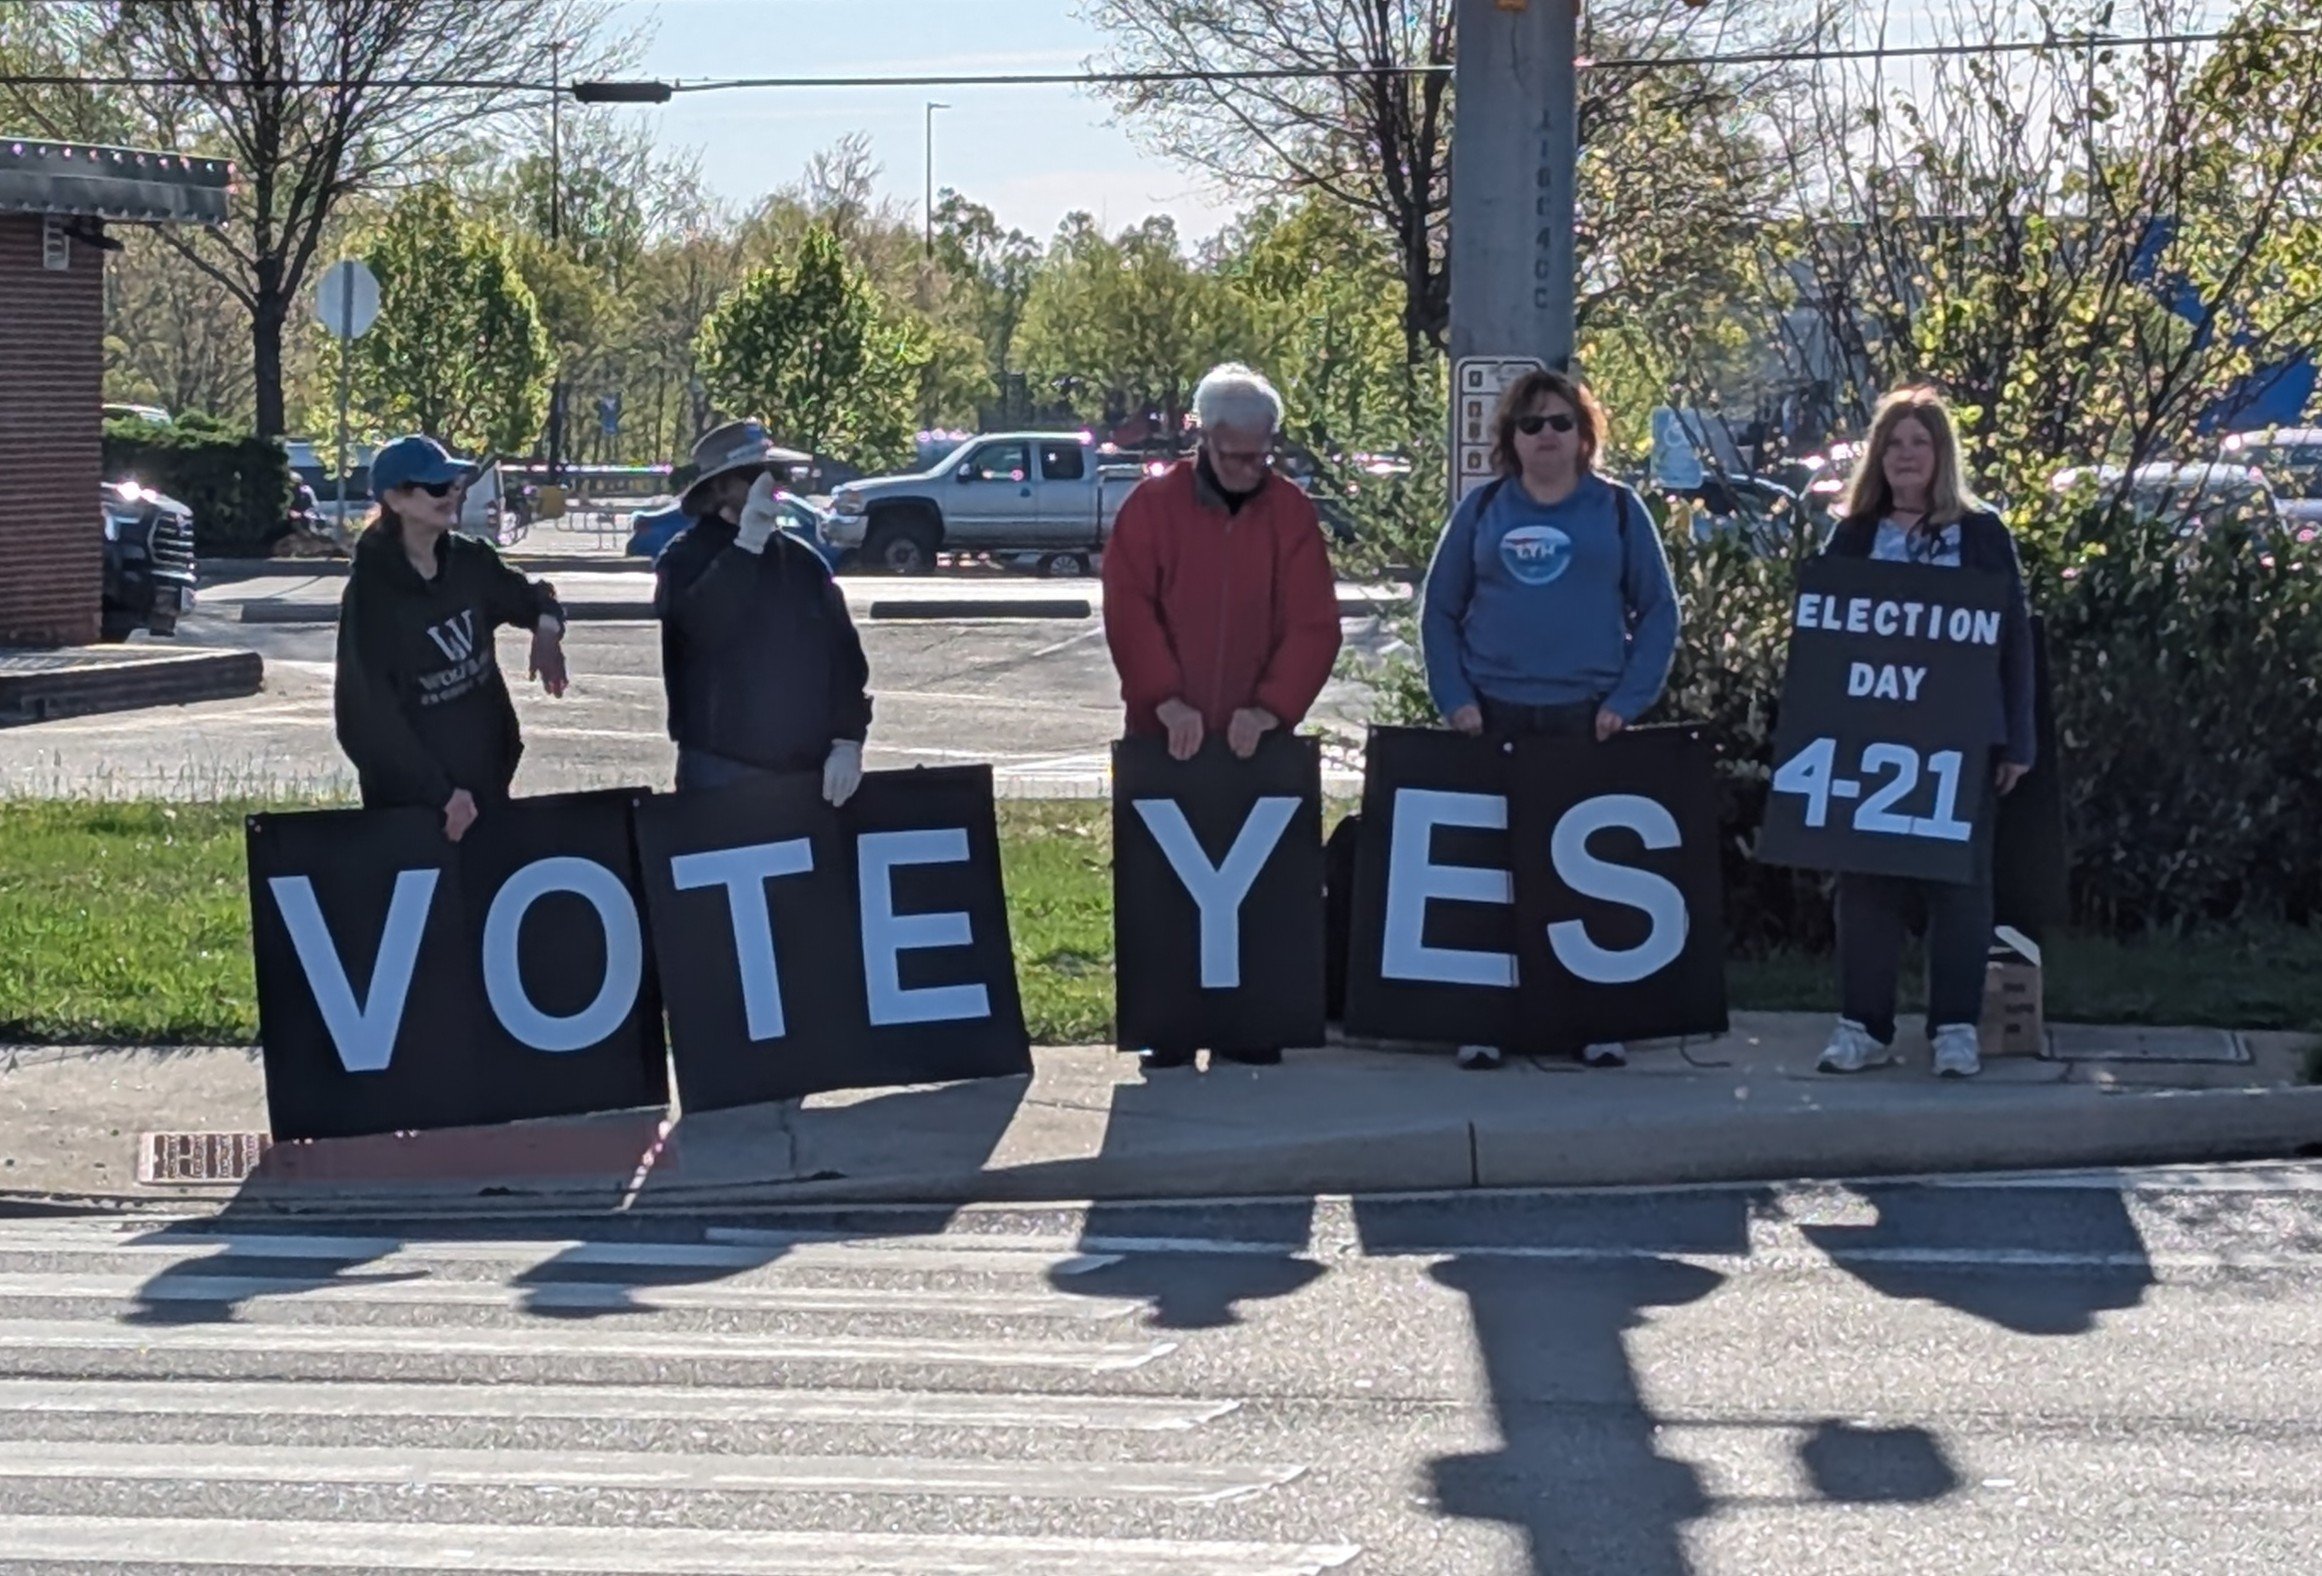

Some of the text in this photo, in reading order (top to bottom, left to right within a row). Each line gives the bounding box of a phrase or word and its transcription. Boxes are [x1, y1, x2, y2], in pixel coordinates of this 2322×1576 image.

[1795, 592, 2003, 647] ELECTION
[1846, 661, 1928, 702] DAY
[1771, 737, 1974, 843] 4-21
[1131, 786, 1690, 989] YES
[267, 826, 992, 1073] VOTE
